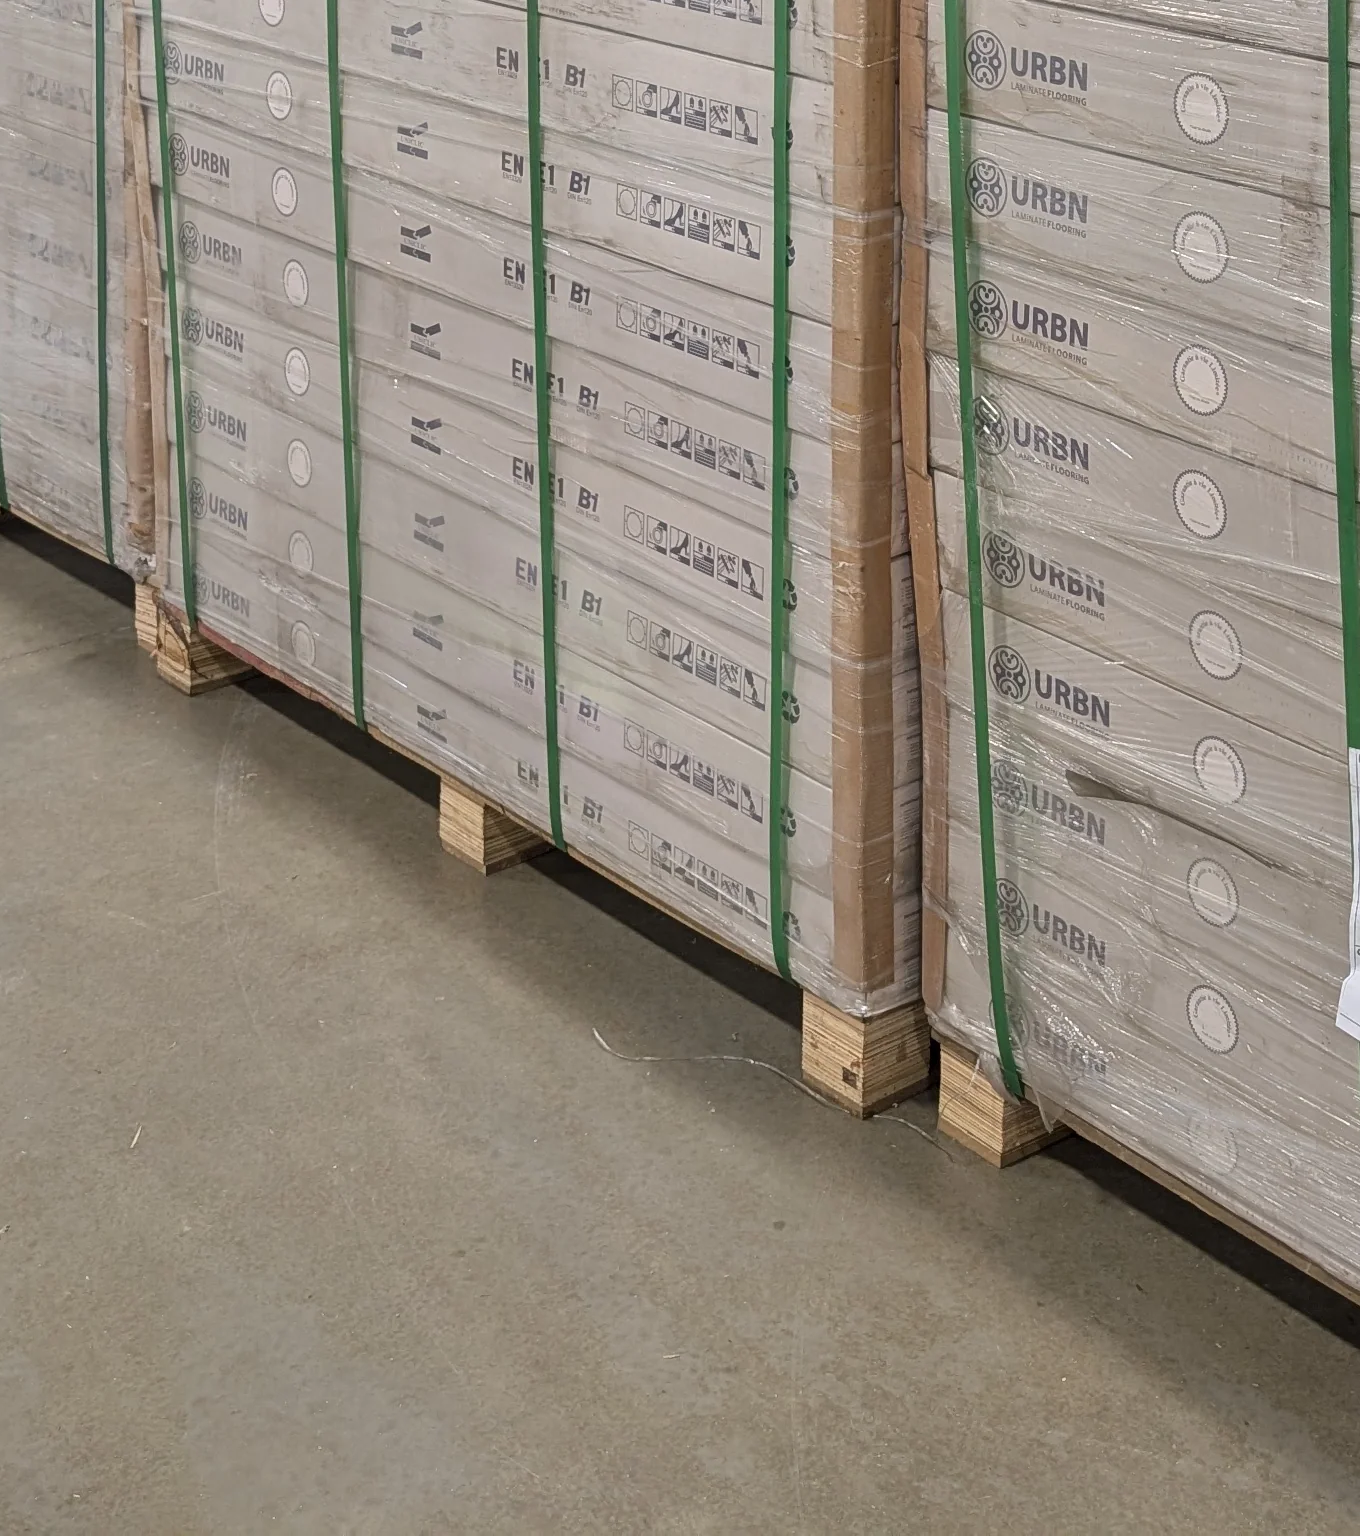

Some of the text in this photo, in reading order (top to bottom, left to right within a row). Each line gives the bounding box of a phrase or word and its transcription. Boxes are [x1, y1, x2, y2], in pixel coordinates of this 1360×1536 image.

[184, 53, 224, 82] URBN
[496, 47, 586, 88] EN B1
[1010, 46, 1088, 92] URBN
[1010, 82, 1087, 107] LAMINATE FLOORING
[190, 145, 230, 178] URBN
[501, 151, 591, 195] EN B1
[1011, 175, 1088, 224] URBN
[1011, 210, 1087, 239] LAMINATE FLOORING
[503, 257, 591, 306] EN B1
[205, 317, 243, 353] URBN
[1012, 299, 1089, 348] URBN
[512, 358, 599, 410] EN B1
[207, 405, 246, 442] URBN
[1013, 416, 1090, 472] URBN
[513, 457, 599, 512] EN B1
[209, 492, 248, 531] URBN
[211, 581, 250, 617] URBN
[515, 557, 603, 616] EN B1
[1028, 553, 1105, 608] URBN
[1030, 584, 1106, 622] LAMINATE FLOORING
[1034, 668, 1110, 728] URBN
[1031, 784, 1106, 846] URBN
[1032, 904, 1107, 967] URBN
